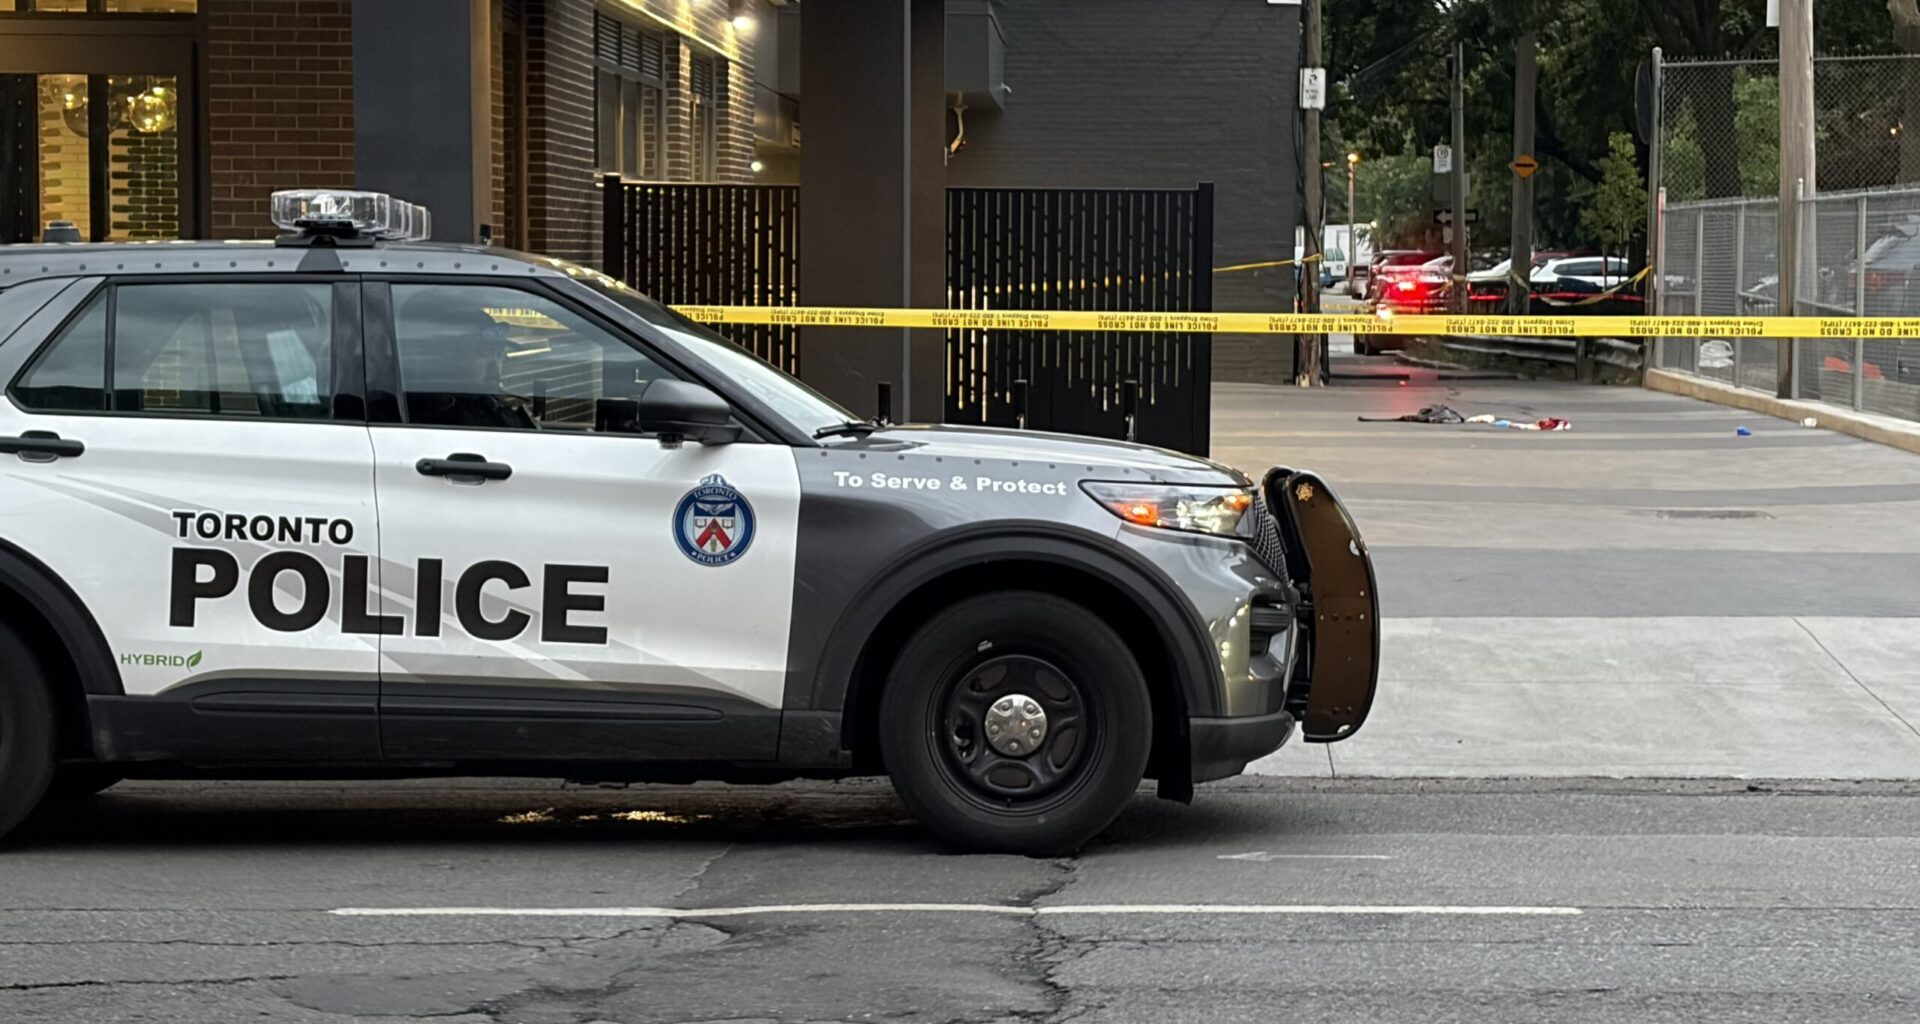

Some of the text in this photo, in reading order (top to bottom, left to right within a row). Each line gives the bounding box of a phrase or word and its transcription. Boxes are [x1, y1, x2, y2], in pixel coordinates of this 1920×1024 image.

[1187, 322, 1218, 330] POLICE
[1820, 328, 1851, 336] CROSS
[833, 471, 1068, 496] To Serve & Protect
[694, 487, 737, 500] TORONTO
[172, 512, 354, 545] TORONTO
[696, 552, 730, 565] POLICE
[169, 547, 610, 644] POLICE
[120, 653, 185, 667] HYBRID
